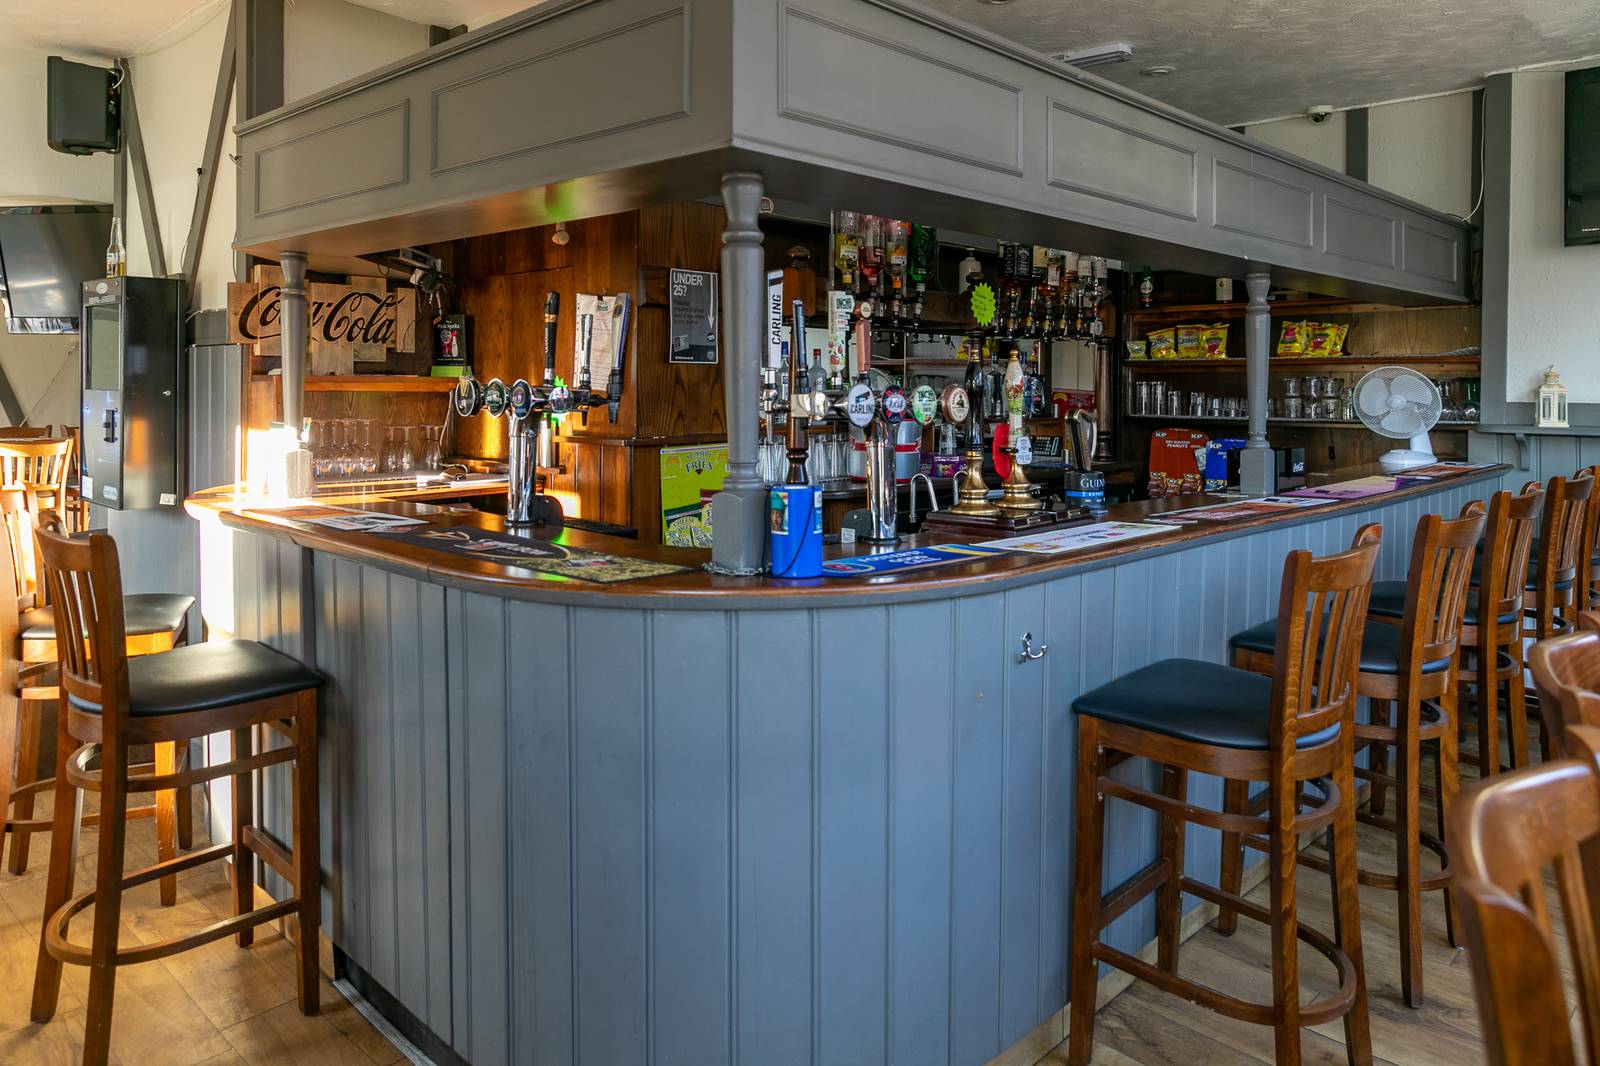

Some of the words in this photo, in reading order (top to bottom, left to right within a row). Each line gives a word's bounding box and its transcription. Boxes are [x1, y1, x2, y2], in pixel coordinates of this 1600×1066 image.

[673, 272, 703, 286] UNDER
[673, 284, 688, 297] 25?
[238, 286, 404, 344] Coa-Cola
[772, 294, 781, 345] CARLING
[685, 460, 713, 473] FRIES
